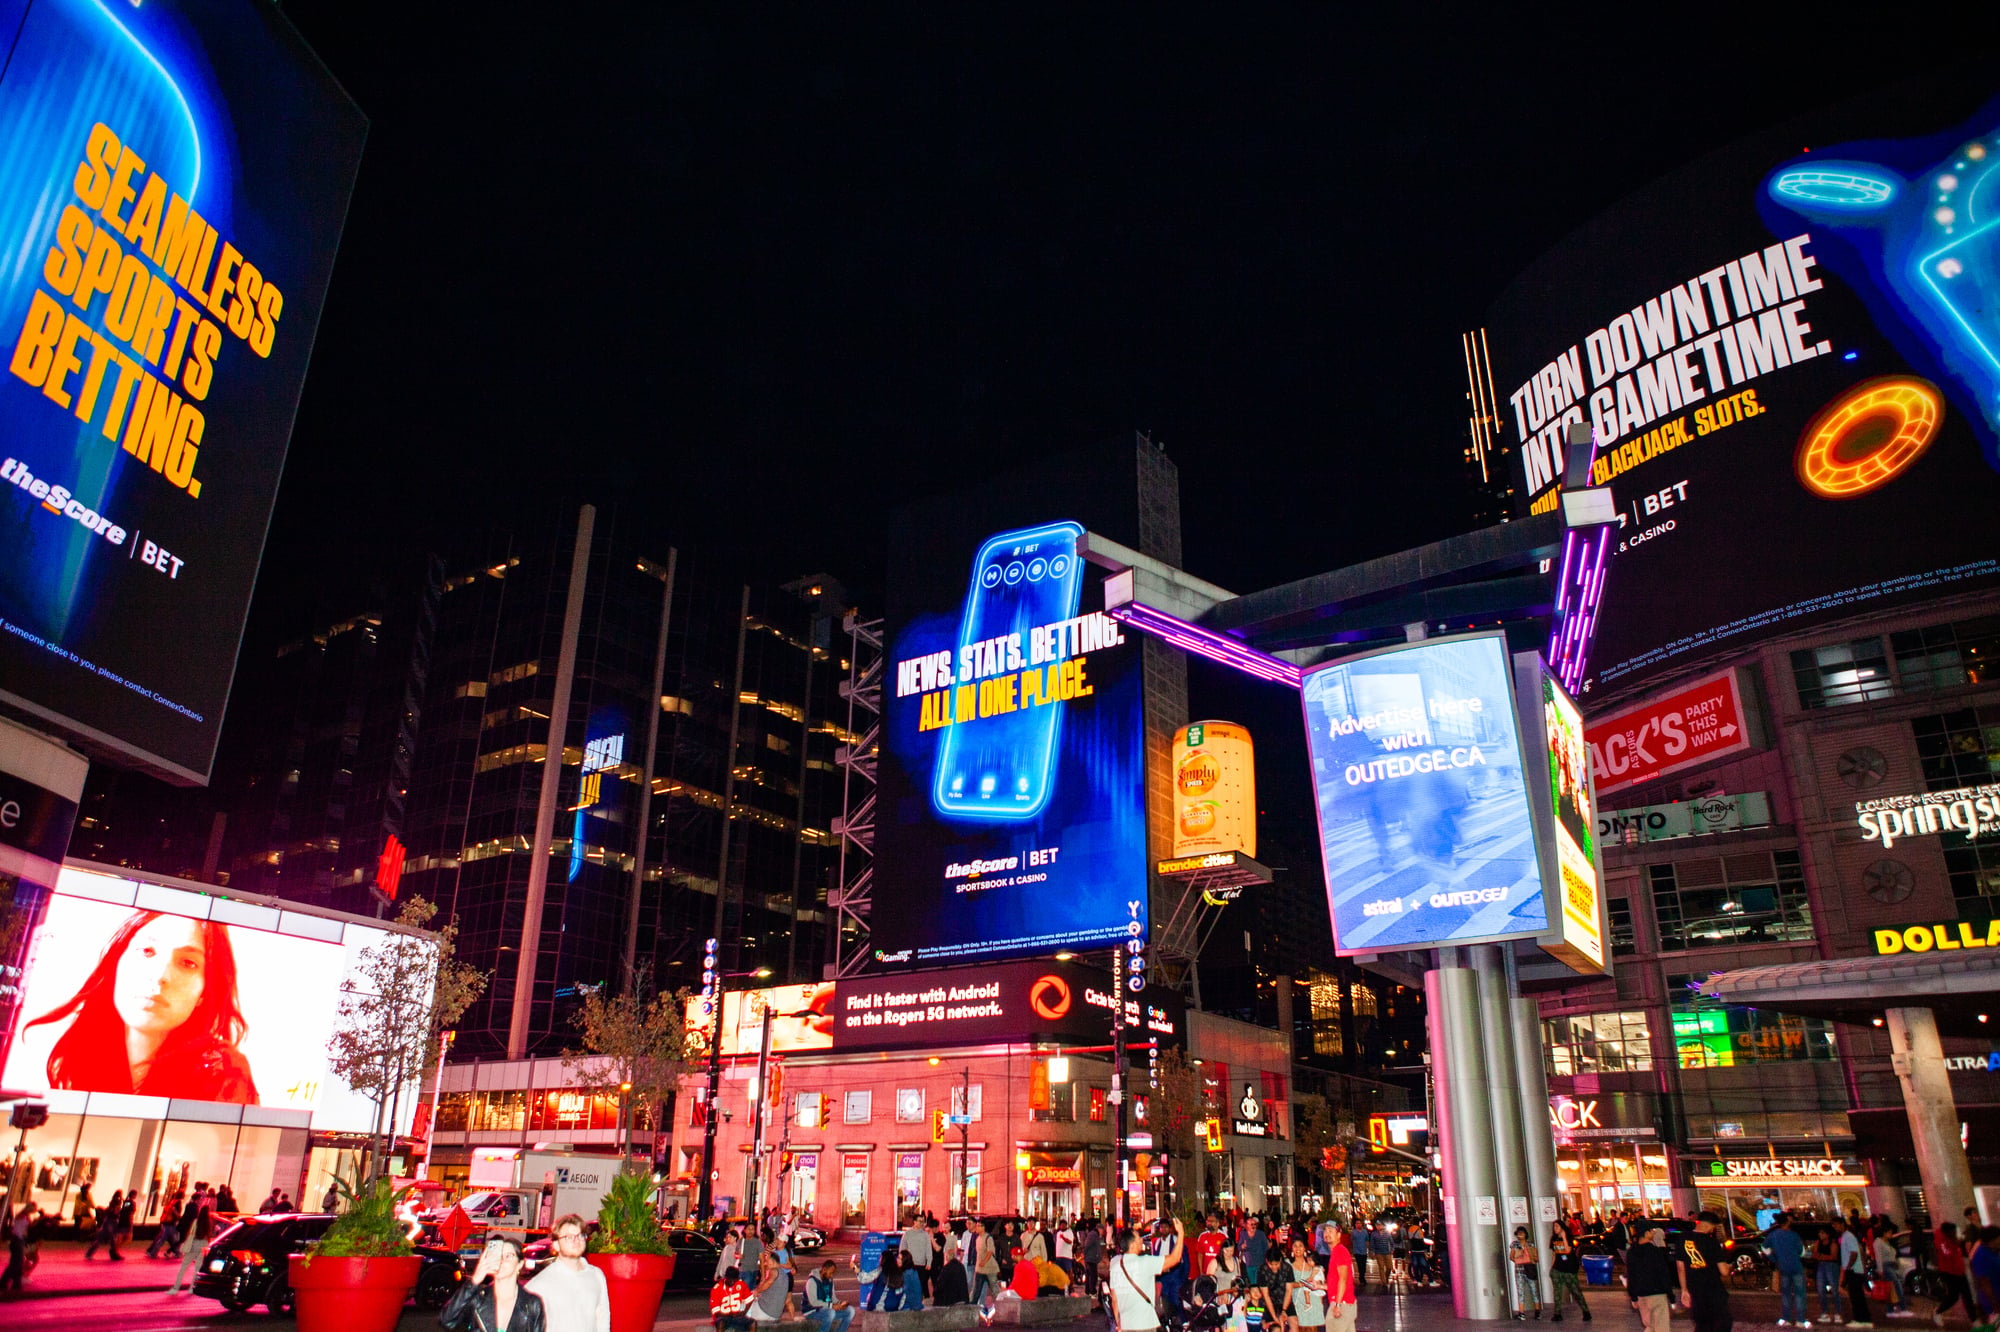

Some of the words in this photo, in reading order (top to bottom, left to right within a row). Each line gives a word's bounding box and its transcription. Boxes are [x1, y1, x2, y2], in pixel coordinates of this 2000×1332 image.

[73, 122, 284, 358] SEAMLESS
[43, 205, 222, 401] SPORTS
[1510, 345, 1586, 443] TURN
[1585, 233, 1824, 388] DOWNTIME
[1590, 299, 1832, 448] GAMETIME.
[9, 288, 206, 499] BETTING.
[1592, 417, 1696, 486] BLACKJACK.
[1694, 389, 1766, 437] SLOTS.
[1644, 479, 1689, 516] BET
[0, 457, 127, 546] theScore
[141, 539, 185, 580] BET
[1025, 543, 1039, 553] BET
[1619, 542, 1628, 552] &
[1630, 519, 1677, 547] CASINO
[1666, 642, 1676, 650] ON
[1715, 625, 1728, 633] you
[1730, 618, 1747, 627] have
[1748, 607, 1784, 622] questions
[1796, 595, 1832, 608] concerns
[1833, 587, 1858, 599] about
[1859, 583, 1878, 593] your
[1881, 574, 1922, 588] gambling
[1935, 567, 1951, 576] the
[1952, 559, 1996, 573] gambling
[1669, 645, 1690, 656] please
[1690, 636, 1716, 648] contact
[1717, 619, 1770, 640] ConnexOntario
[1781, 598, 1843, 619] 1-866-531-2600
[1845, 595, 1855, 603] to
[1856, 590, 1881, 601] speak
[1894, 584, 1906, 592] an
[1907, 576, 1942, 589] advisor,
[1944, 573, 1962, 581] free
[1964, 570, 1974, 578] of
[897, 649, 956, 698] NEWS.
[959, 633, 1026, 681] STATS.
[1030, 611, 1124, 662] BETTING.
[4, 621, 45, 647] someone
[46, 641, 68, 658] close
[69, 652, 79, 663] to
[80, 658, 97, 673] you,
[98, 667, 124, 684] please
[125, 679, 153, 698] contact
[153, 692, 204, 723] ConnexOntario
[919, 685, 954, 732] ALL
[955, 681, 976, 724] IN
[979, 672, 1018, 718] ONE
[1021, 656, 1093, 711] PLACE.
[1685, 695, 1724, 720] PARTY
[1329, 705, 1425, 738] Advertise
[1429, 696, 1483, 718] here
[1688, 713, 1718, 733] THIS
[1382, 728, 1432, 752] with
[1627, 730, 1640, 769] ASTORS
[1691, 728, 1718, 747] WAY
[1178, 765, 1216, 783] Simply
[1345, 746, 1487, 786] OUTEDGE.CA
[1693, 805, 1714, 815] Hard
[1714, 802, 1735, 813] Rock
[945, 856, 1018, 879] theScore
[1029, 847, 1059, 866] BET
[956, 878, 1008, 893] SPORTSBOOK
[1009, 876, 1015, 886] &
[1016, 872, 1047, 885] CASINO
[1363, 897, 1403, 917] astral
[1127, 900, 1145, 992] Yonge
[847, 993, 871, 1010] Find
[873, 993, 883, 1008] it
[884, 992, 918, 1007] faster
[919, 988, 946, 1004] with
[948, 982, 1000, 1001] Android
[1085, 988, 1107, 1007] Circle
[1114, 949, 1122, 1014] DOWNTOWN
[846, 1015, 861, 1027] on
[863, 1011, 882, 1025] the
[884, 1010, 925, 1027] Rogers
[926, 1006, 945, 1021] 5G
[947, 1001, 1003, 1020] network.
[1148, 1005, 1167, 1021] Google
[570, 1174, 599, 1184] AEGION
[1047, 1168, 1081, 1179] ROGERS
[1726, 1160, 1782, 1176] SHAKE
[1784, 1159, 1846, 1176] SHACK
[721, 1293, 740, 1313] 25
